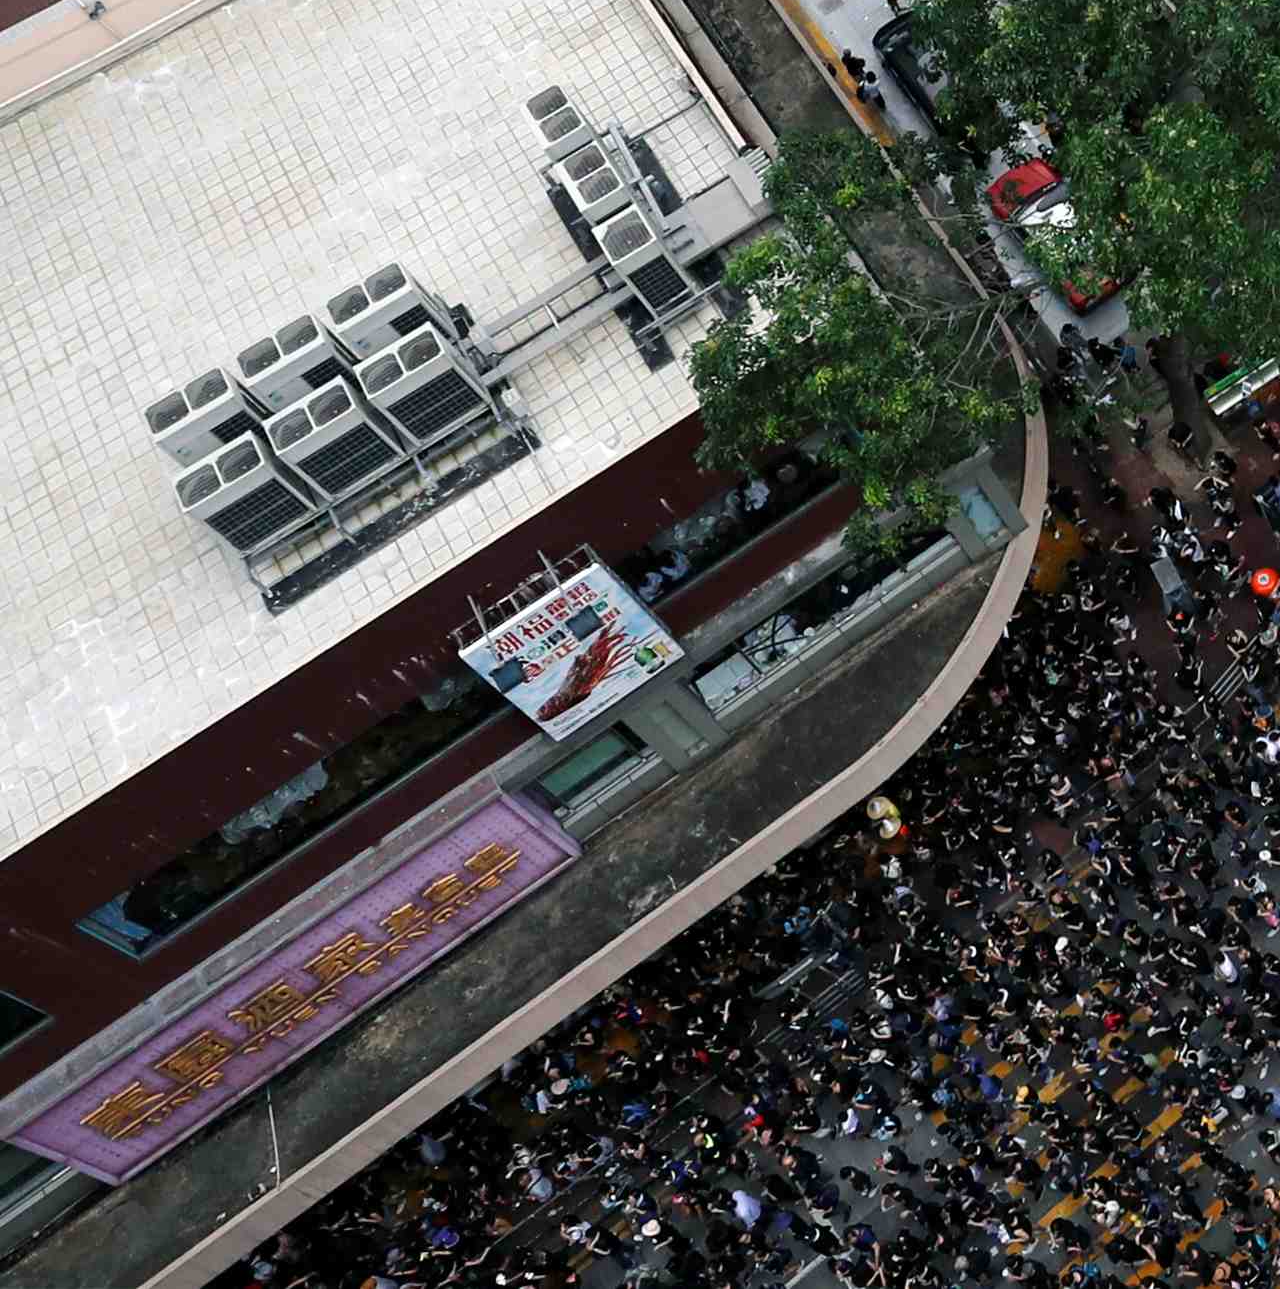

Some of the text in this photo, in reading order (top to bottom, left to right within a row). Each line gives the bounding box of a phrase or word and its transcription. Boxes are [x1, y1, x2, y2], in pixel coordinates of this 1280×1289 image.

[122, 858, 518, 1140] TUNG YUEN BANQUET
